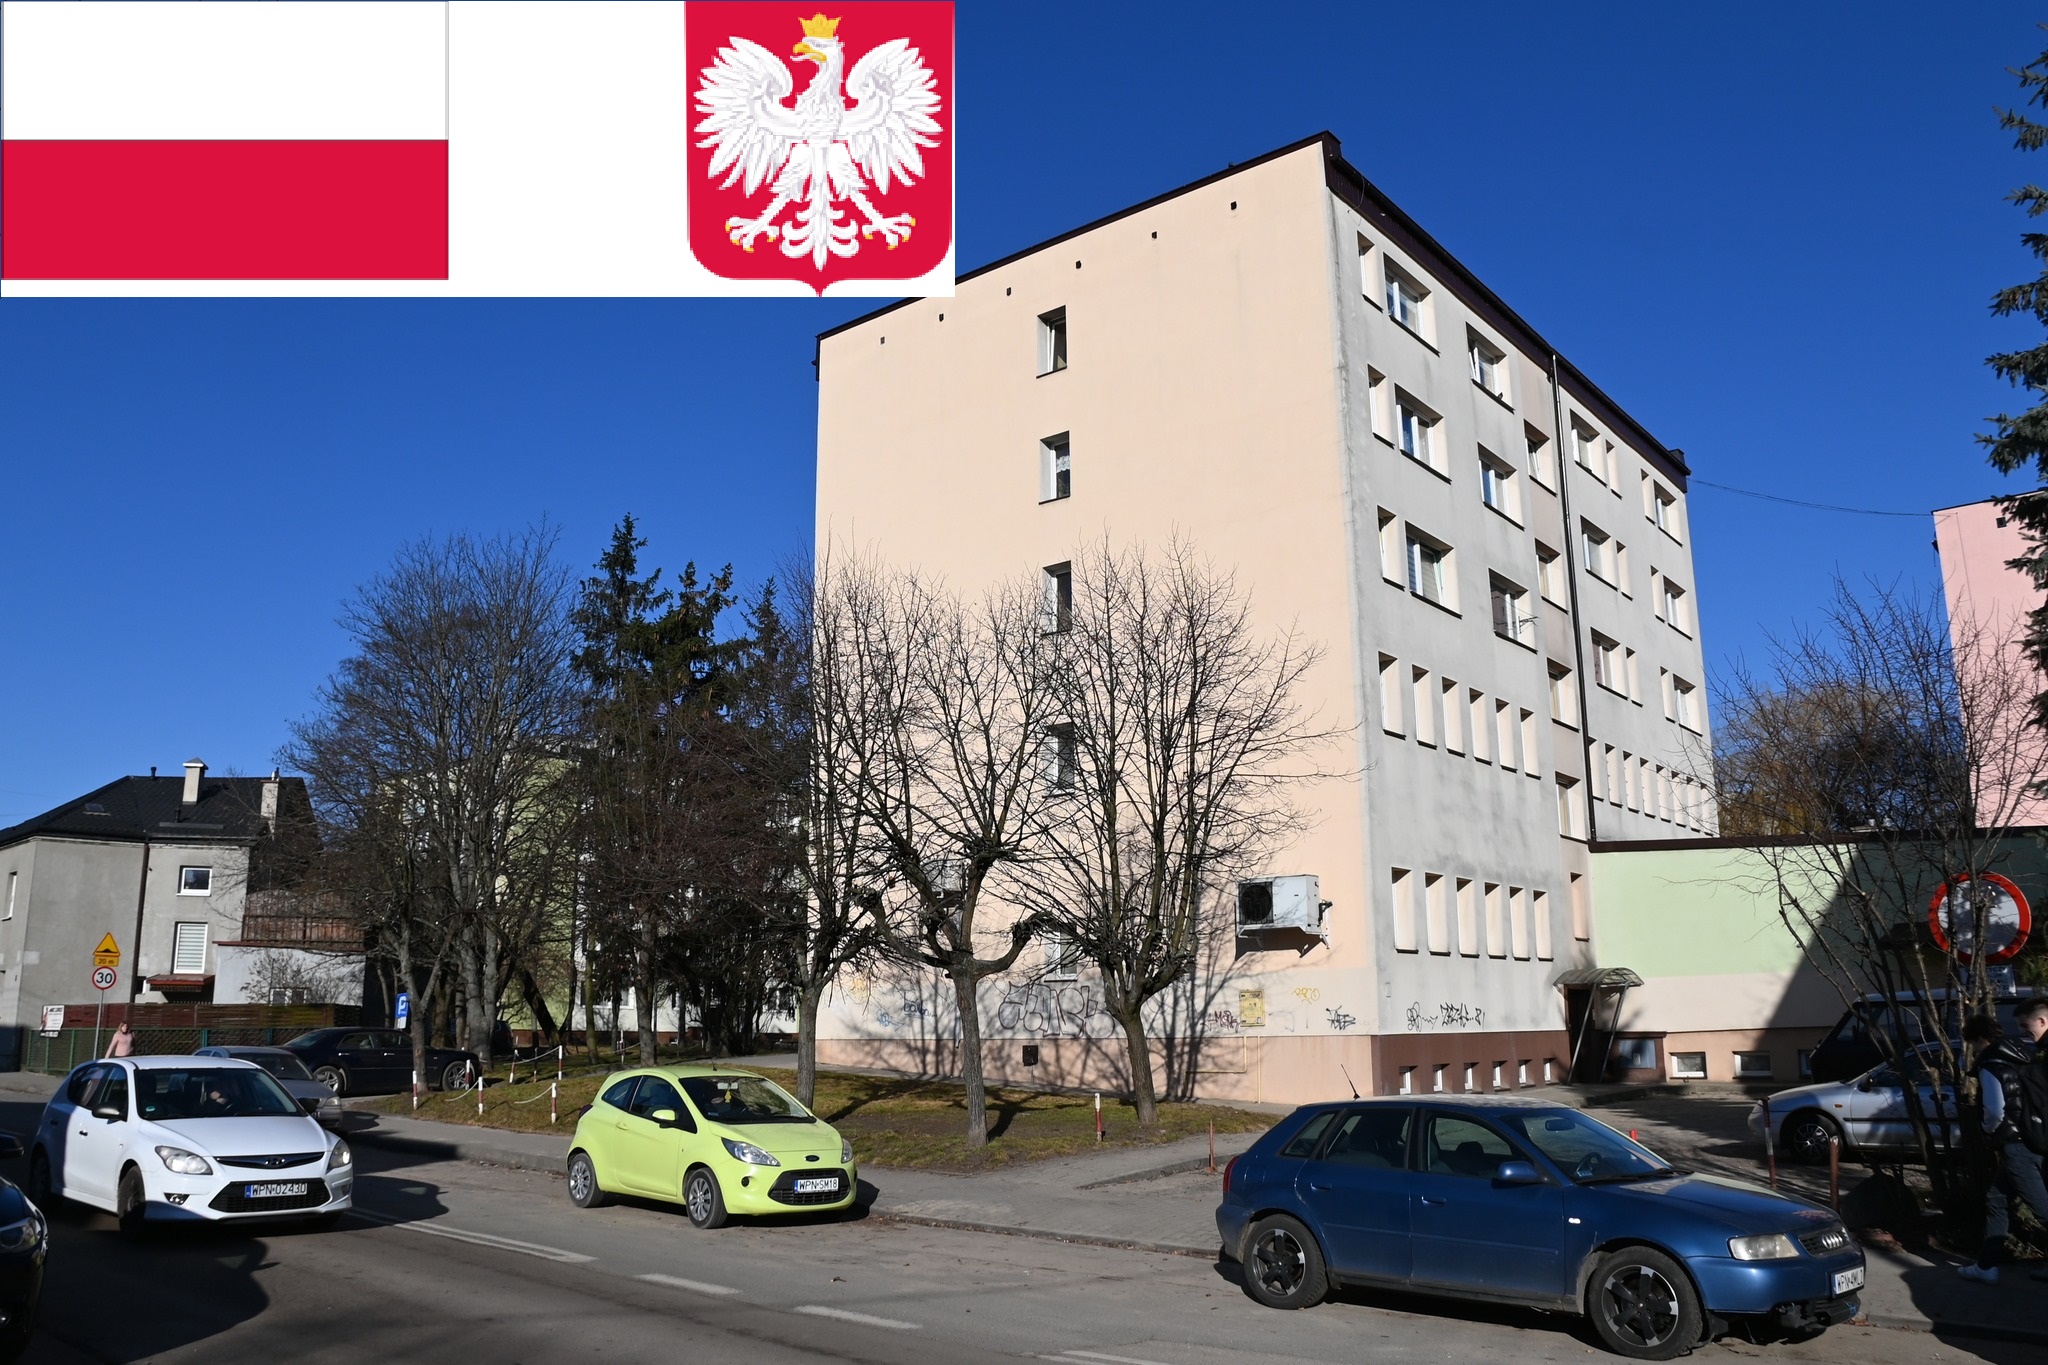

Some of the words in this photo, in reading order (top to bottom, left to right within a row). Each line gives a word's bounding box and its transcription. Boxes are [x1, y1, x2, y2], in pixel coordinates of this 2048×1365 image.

[96, 972, 113, 984] 30
[398, 995, 407, 1015] P
[252, 1184, 272, 1196] WPN
[800, 1180, 817, 1190] WPN
